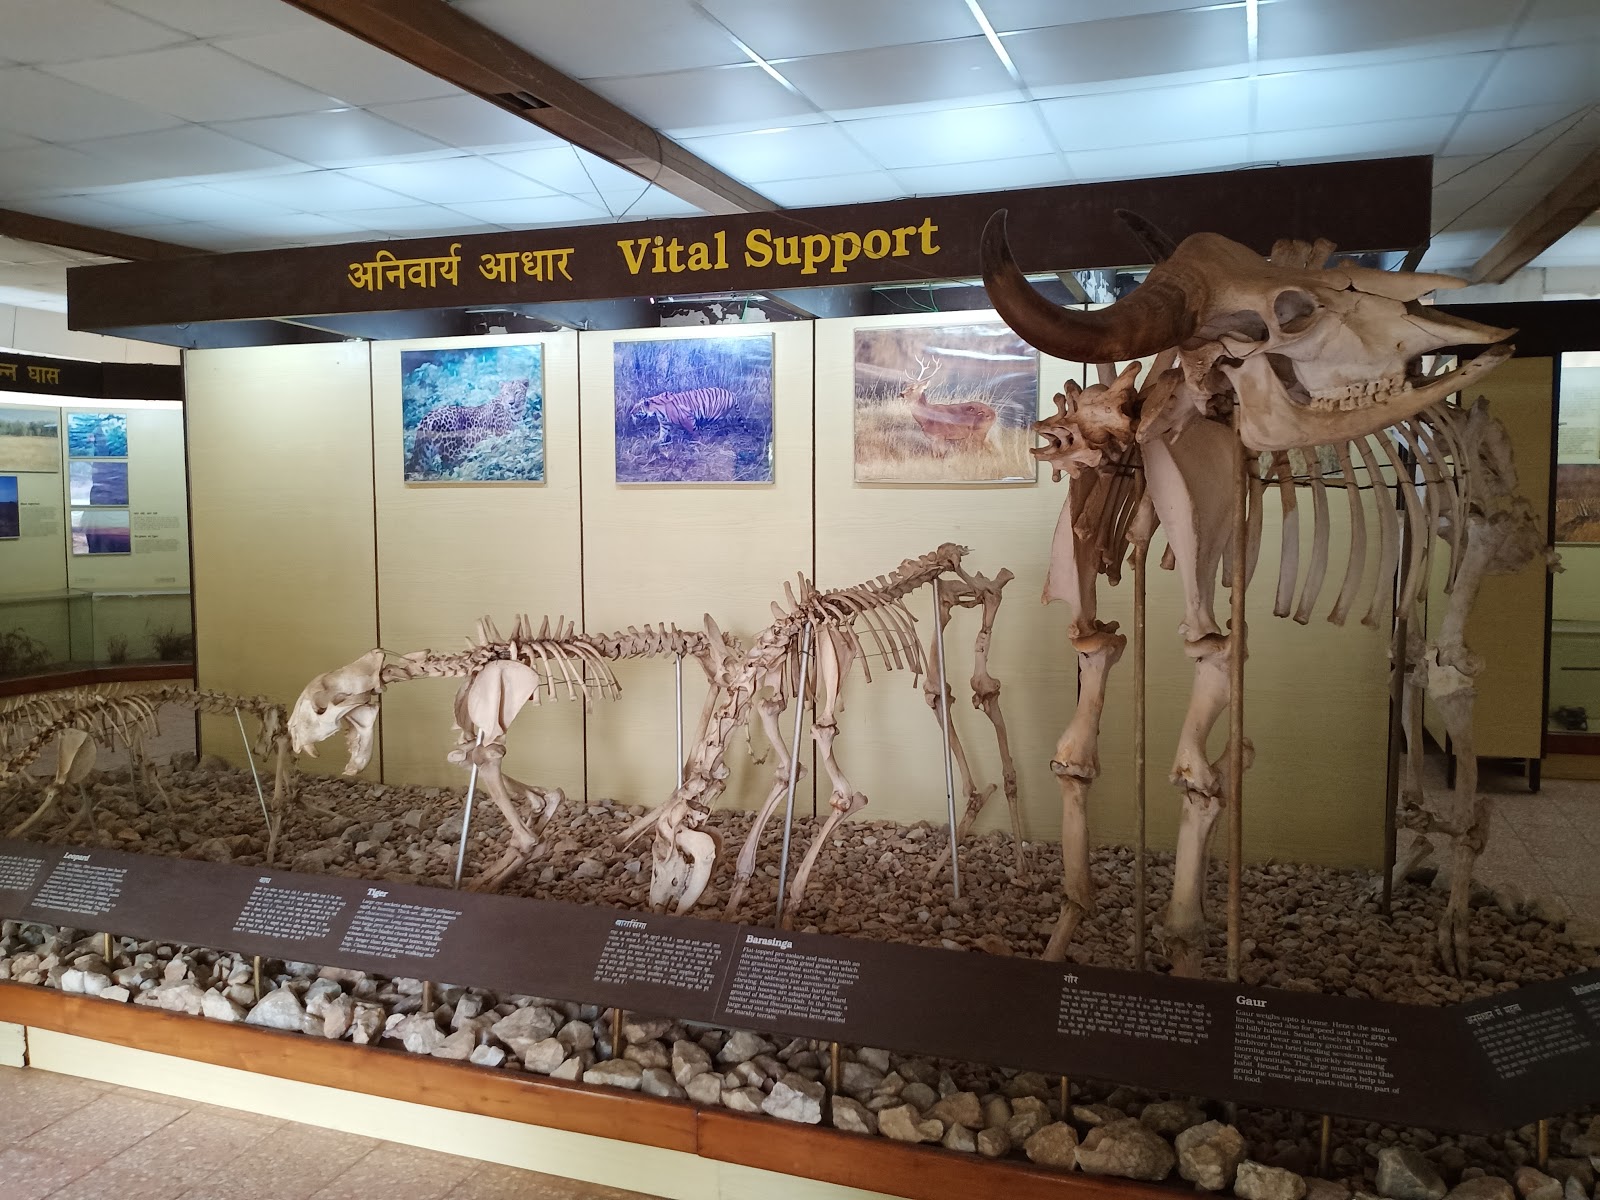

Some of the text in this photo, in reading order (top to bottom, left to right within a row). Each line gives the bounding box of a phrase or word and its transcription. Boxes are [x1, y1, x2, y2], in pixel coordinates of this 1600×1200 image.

[617, 219, 939, 274] Vital Support
[349, 243, 573, 291] अनिवार्य आधार
[27, 366, 60, 384] घास
[63, 852, 90, 861] Leopard
[367, 888, 389, 898] Tiger
[746, 934, 792, 949] Barasinga
[1064, 973, 1078, 984] गौर
[1236, 996, 1267, 1008] Gaur
[1235, 1032, 1270, 1040] withstand
[1235, 1037, 1268, 1047] herbivore
[1304, 1047, 1330, 1056] feeding
[1363, 1039, 1389, 1048] hooves
[1234, 1052, 1252, 1060] large
[1310, 1062, 1328, 1070] large
[1235, 1046, 1265, 1055] morning
[1314, 1057, 1341, 1065] quickly
[1343, 1060, 1385, 1071] consuming
[1355, 1082, 1372, 1090] form
[1360, 1076, 1376, 1084] help
